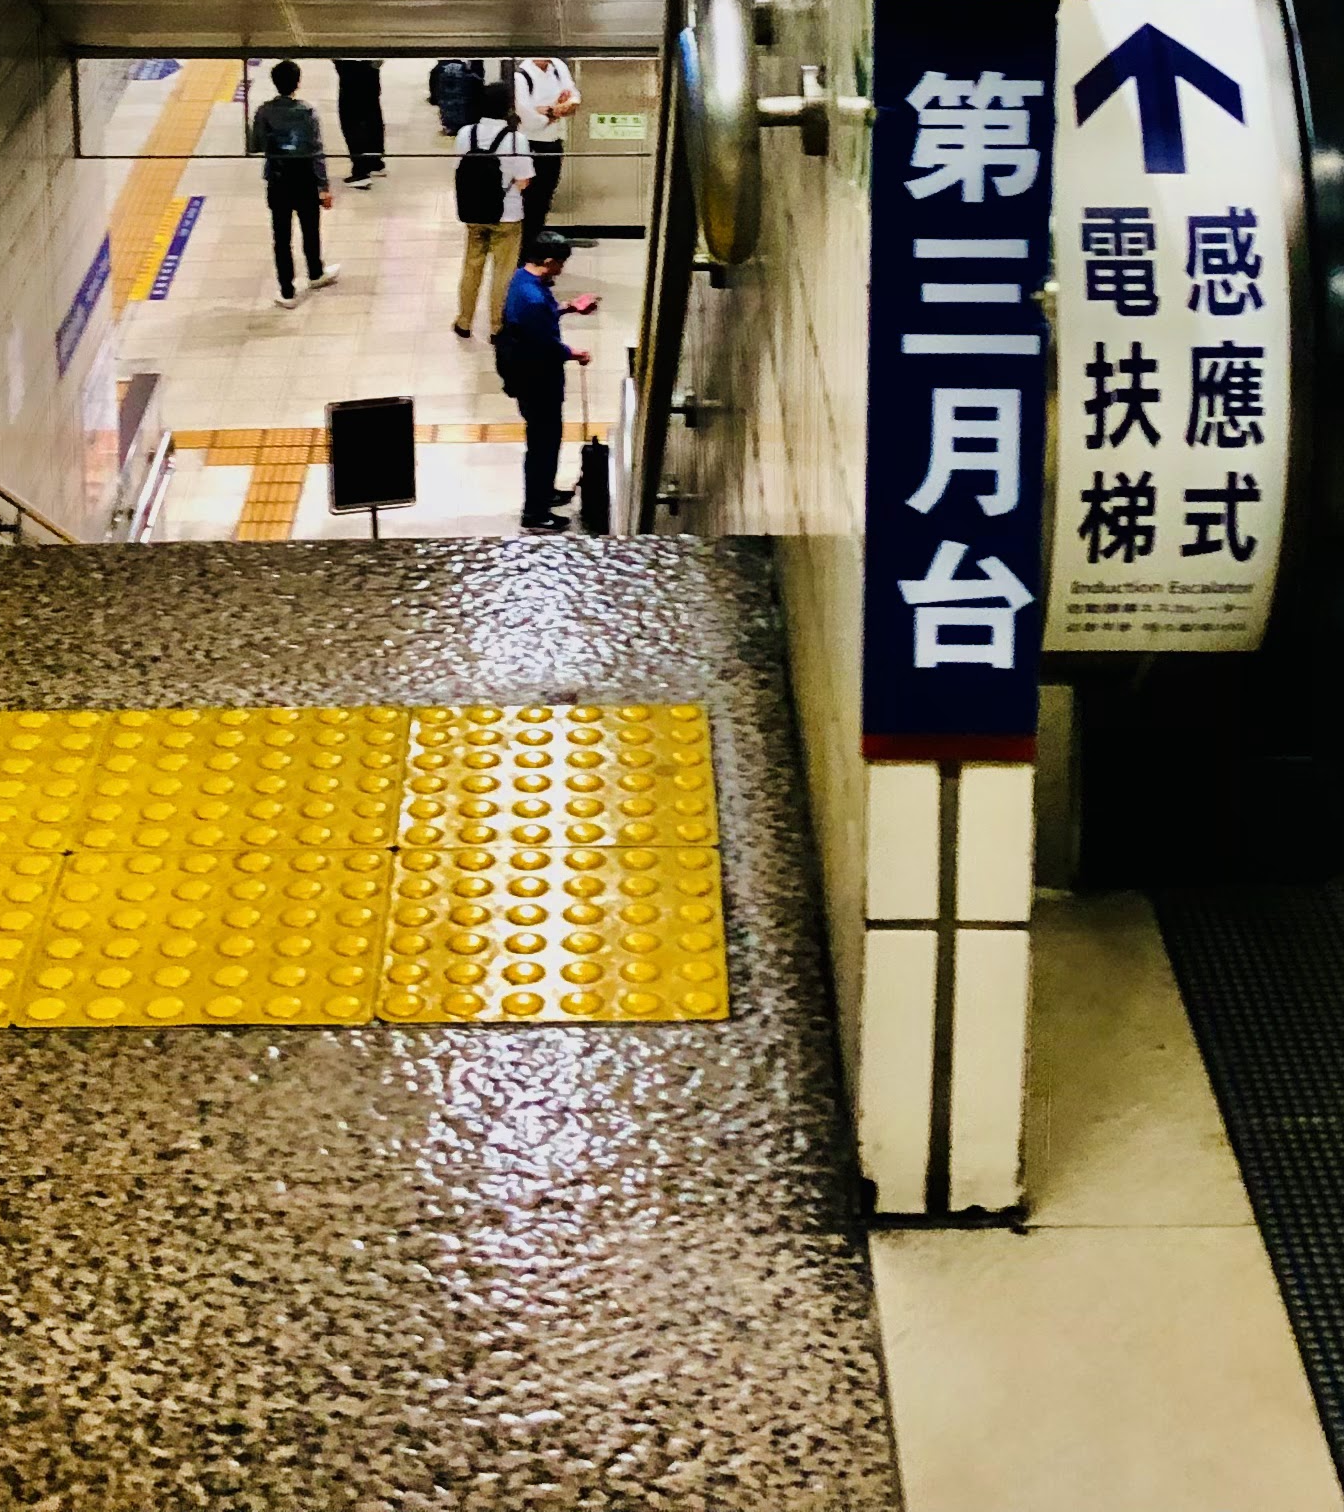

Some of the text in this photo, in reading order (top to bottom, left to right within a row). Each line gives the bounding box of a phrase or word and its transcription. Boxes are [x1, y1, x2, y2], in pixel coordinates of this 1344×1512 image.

[898, 70, 1044, 670] 第三月台
[1076, 206, 1163, 565] 電扶梯
[1182, 205, 1266, 564] 感應式
